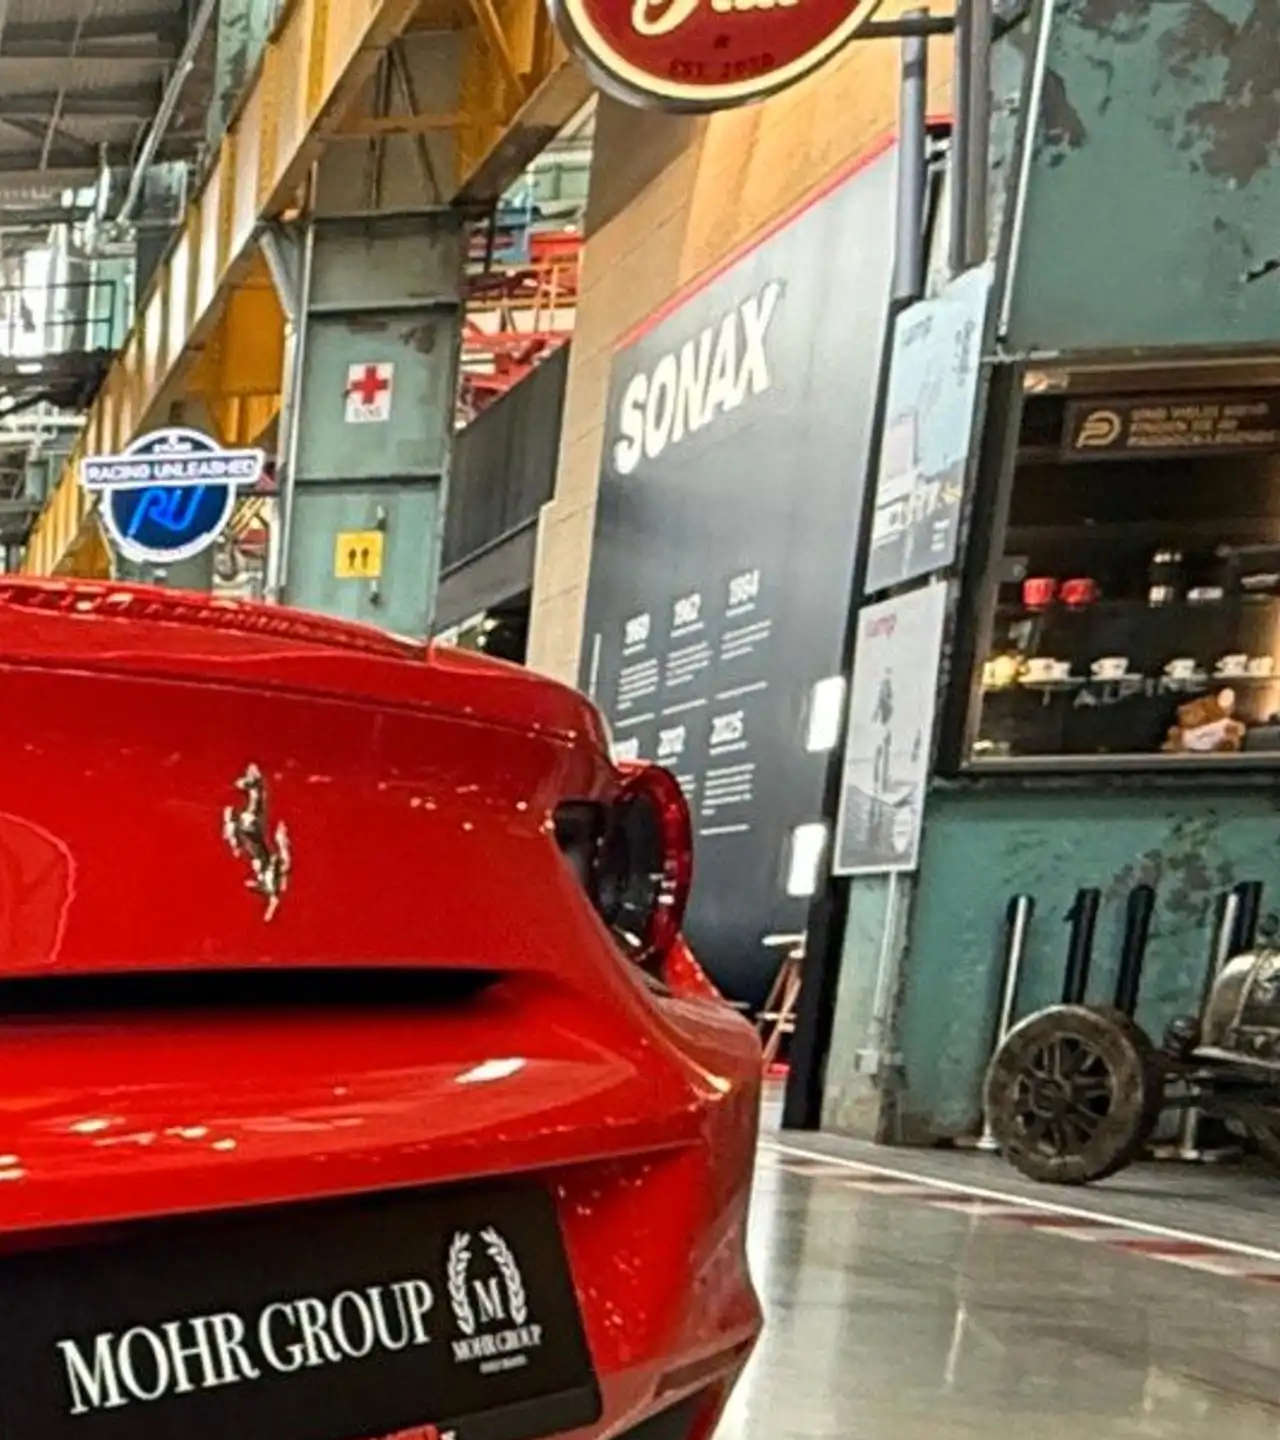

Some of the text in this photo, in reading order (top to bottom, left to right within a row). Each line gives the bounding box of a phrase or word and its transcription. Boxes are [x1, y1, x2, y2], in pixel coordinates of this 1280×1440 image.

[613, 281, 780, 475] SONAX
[153, 459, 254, 478] UNLEASHED
[472, 1275, 506, 1322] M
[56, 1279, 434, 1415] MOHR GROUP
